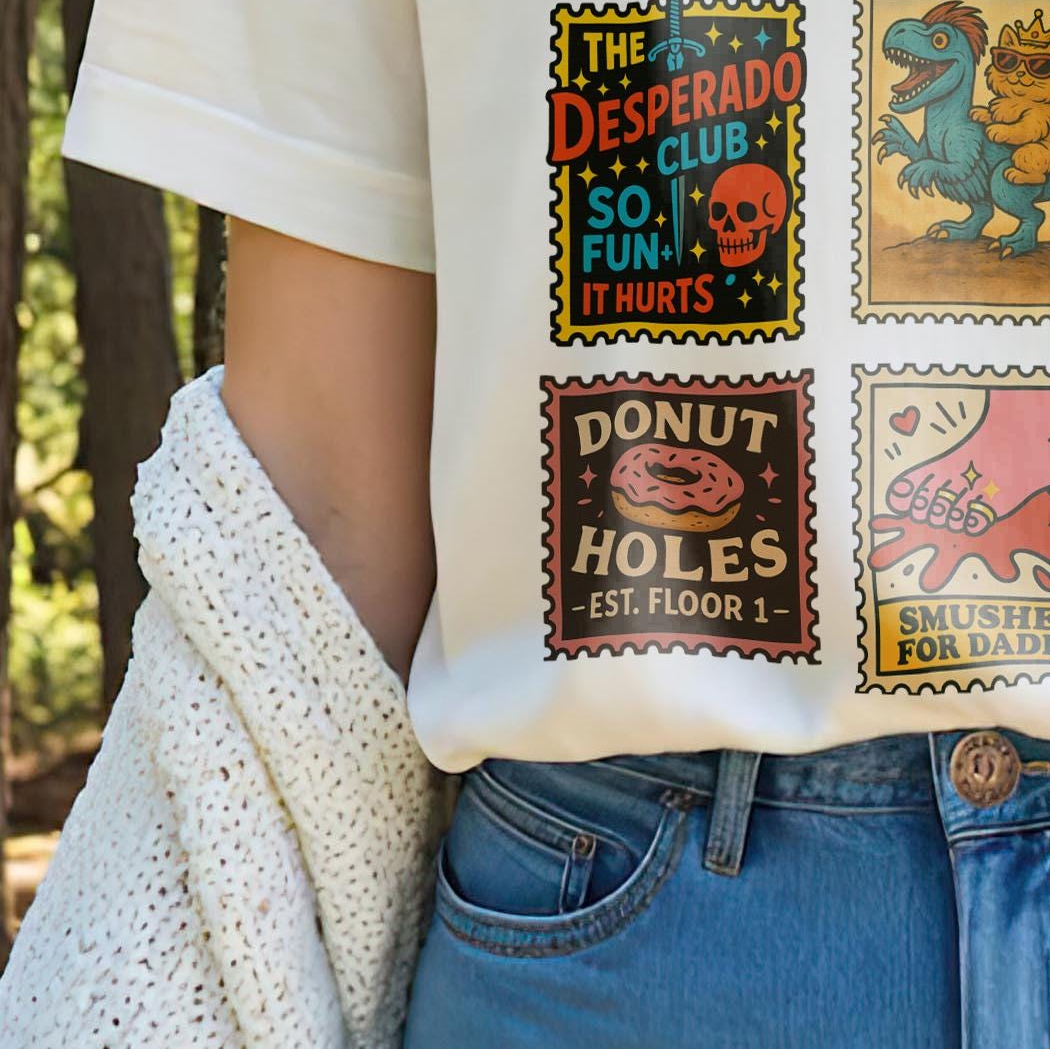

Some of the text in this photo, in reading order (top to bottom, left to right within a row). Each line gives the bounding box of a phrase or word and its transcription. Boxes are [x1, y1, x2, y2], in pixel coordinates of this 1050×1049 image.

[583, 31, 645, 72] THE
[551, 51, 802, 162] DESPERADO
[657, 121, 748, 175] CLUB
[587, 185, 650, 229] SO
[583, 273, 715, 316] IT HURTS
[574, 400, 778, 457] DONUT
[571, 525, 788, 582] HOLES
[648, 587, 743, 621] FLOOR
[897, 634, 961, 665] FOR
